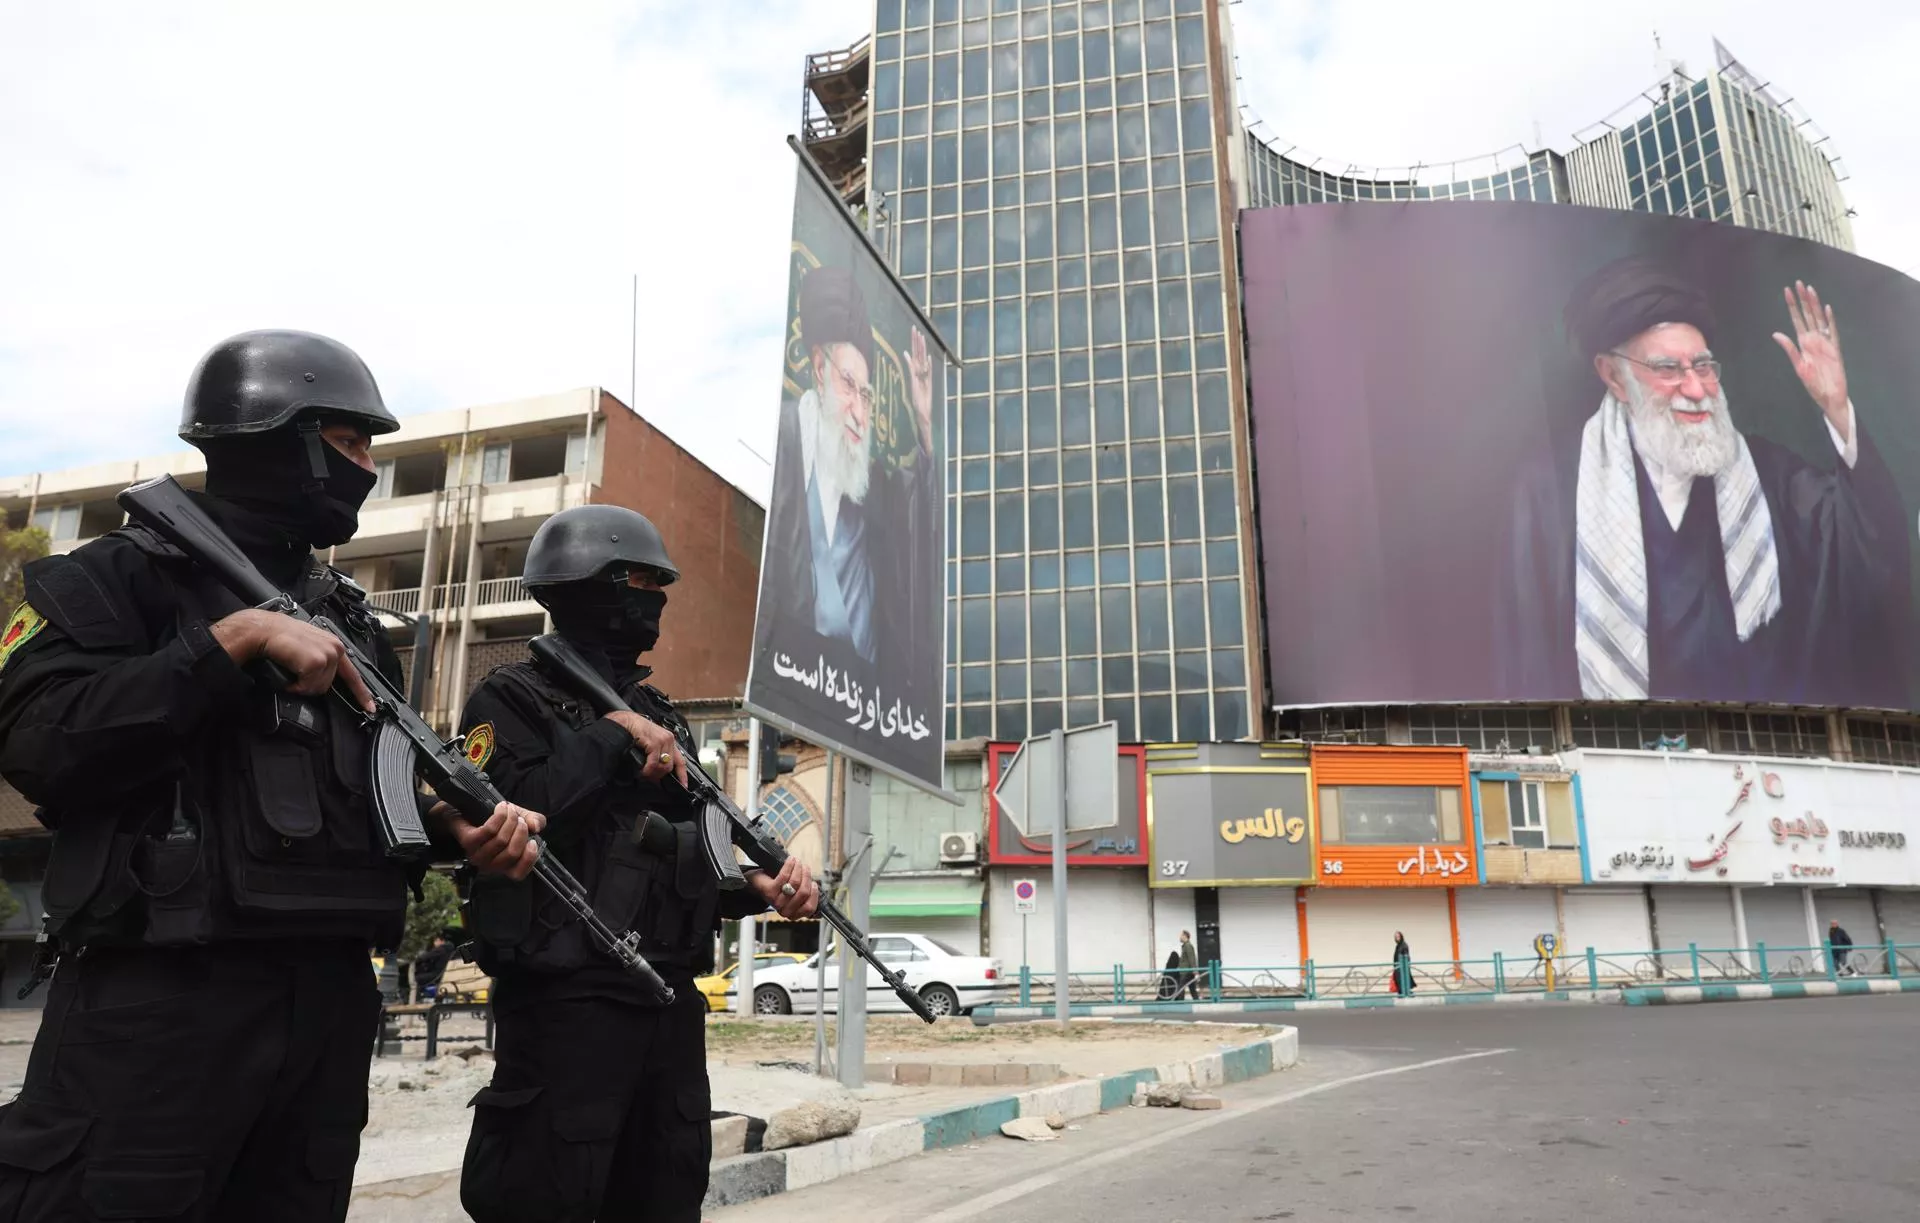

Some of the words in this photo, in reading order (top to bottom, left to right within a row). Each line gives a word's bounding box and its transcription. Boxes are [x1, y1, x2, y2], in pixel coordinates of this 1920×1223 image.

[773, 652, 824, 693] است
[825, 665, 864, 724] زنده
[859, 686, 881, 731] او
[879, 697, 931, 740] خدای
[1220, 808, 1305, 844] والس
[1162, 860, 1189, 876] 37
[1323, 860, 1343, 874] 36
